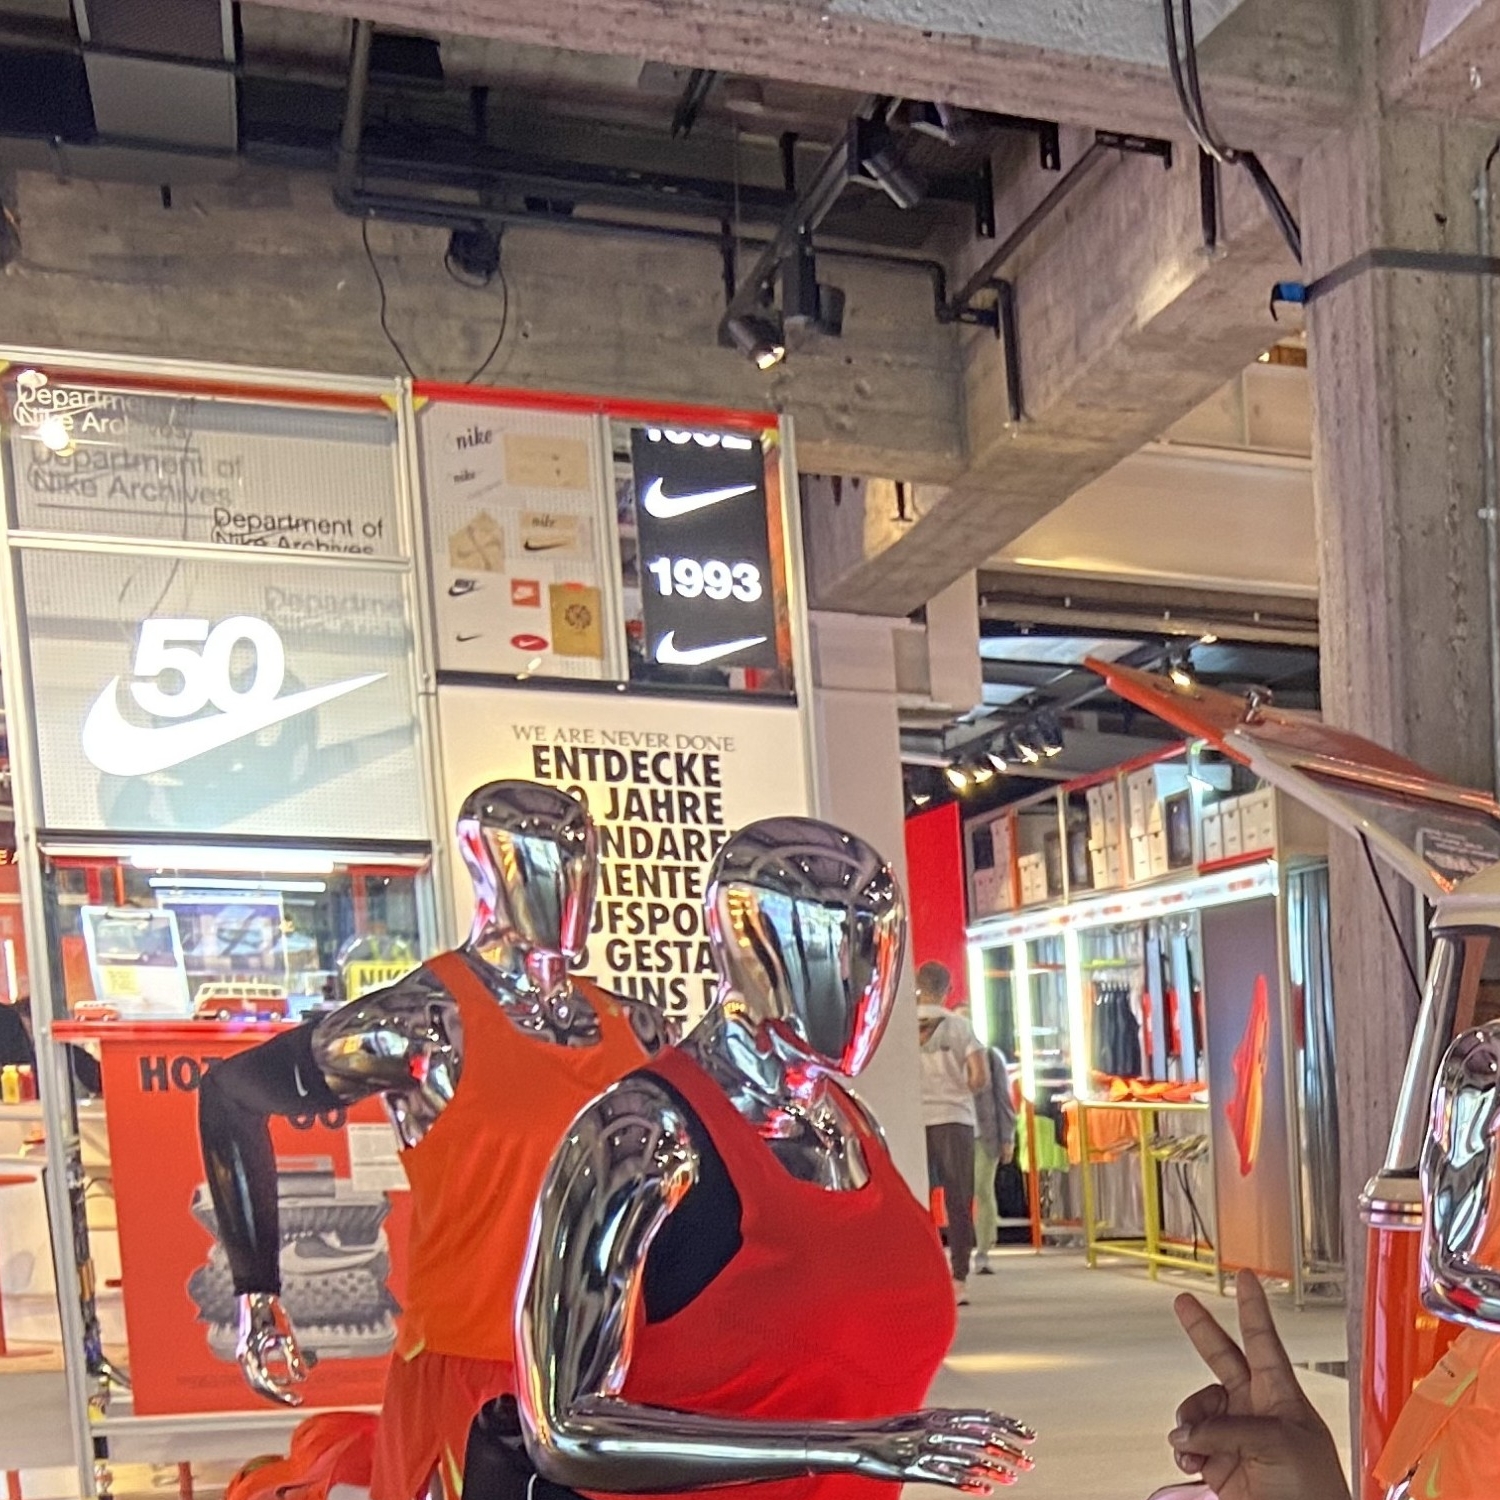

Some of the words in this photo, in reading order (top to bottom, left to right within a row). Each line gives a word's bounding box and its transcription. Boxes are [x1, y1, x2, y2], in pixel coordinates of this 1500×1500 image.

[456, 427, 492, 450] nike
[214, 506, 354, 537] Department
[362, 517, 383, 538] of
[649, 556, 763, 602] 1993
[130, 616, 285, 718] 50
[512, 725, 547, 742] WE
[553, 728, 596, 745] ARE
[600, 730, 670, 748] NEVER
[676, 734, 736, 752] DONE
[532, 744, 722, 788] ENTDECKE
[604, 787, 724, 825] JAHRE
[605, 938, 718, 974] GESTA
